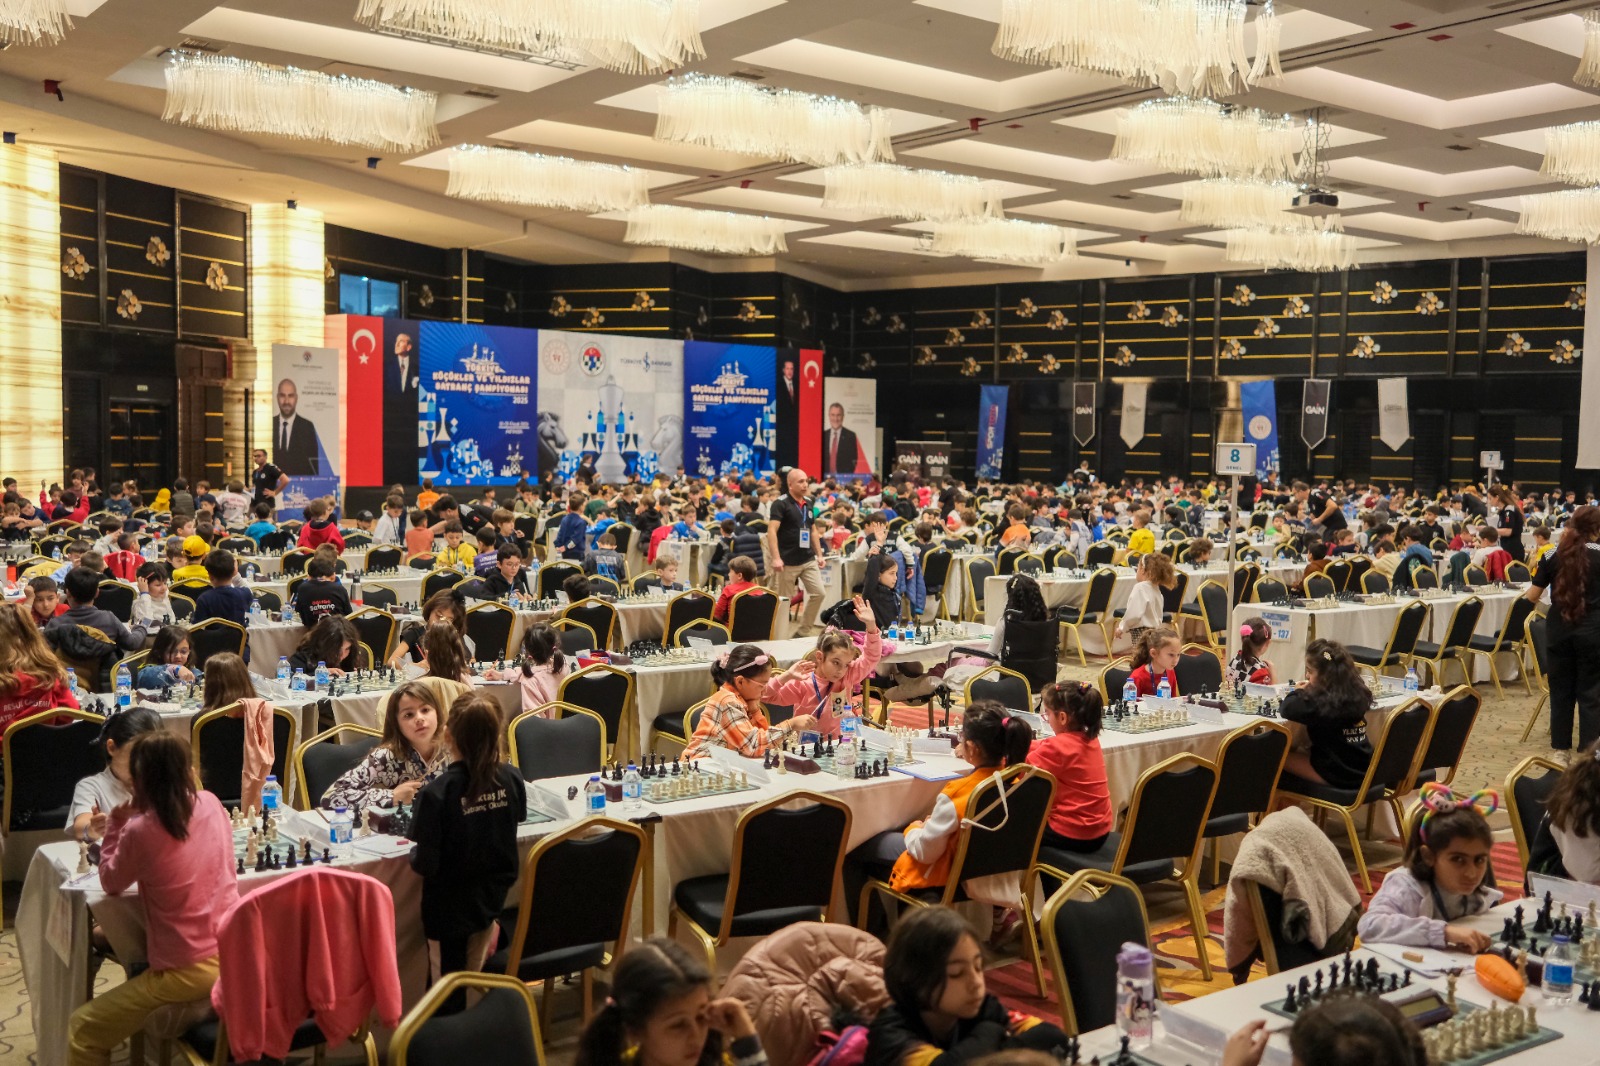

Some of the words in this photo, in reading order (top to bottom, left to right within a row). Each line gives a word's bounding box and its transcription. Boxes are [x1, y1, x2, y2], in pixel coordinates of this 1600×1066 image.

[432, 371, 474, 382] KÜÇÜKLER
[489, 375, 531, 384] YILDIZLAR
[435, 382, 473, 393] SATRANÇ
[474, 384, 529, 394] ŞAMPİYONASI
[1230, 448, 1241, 463] 8
[1278, 629, 1289, 639] 137
